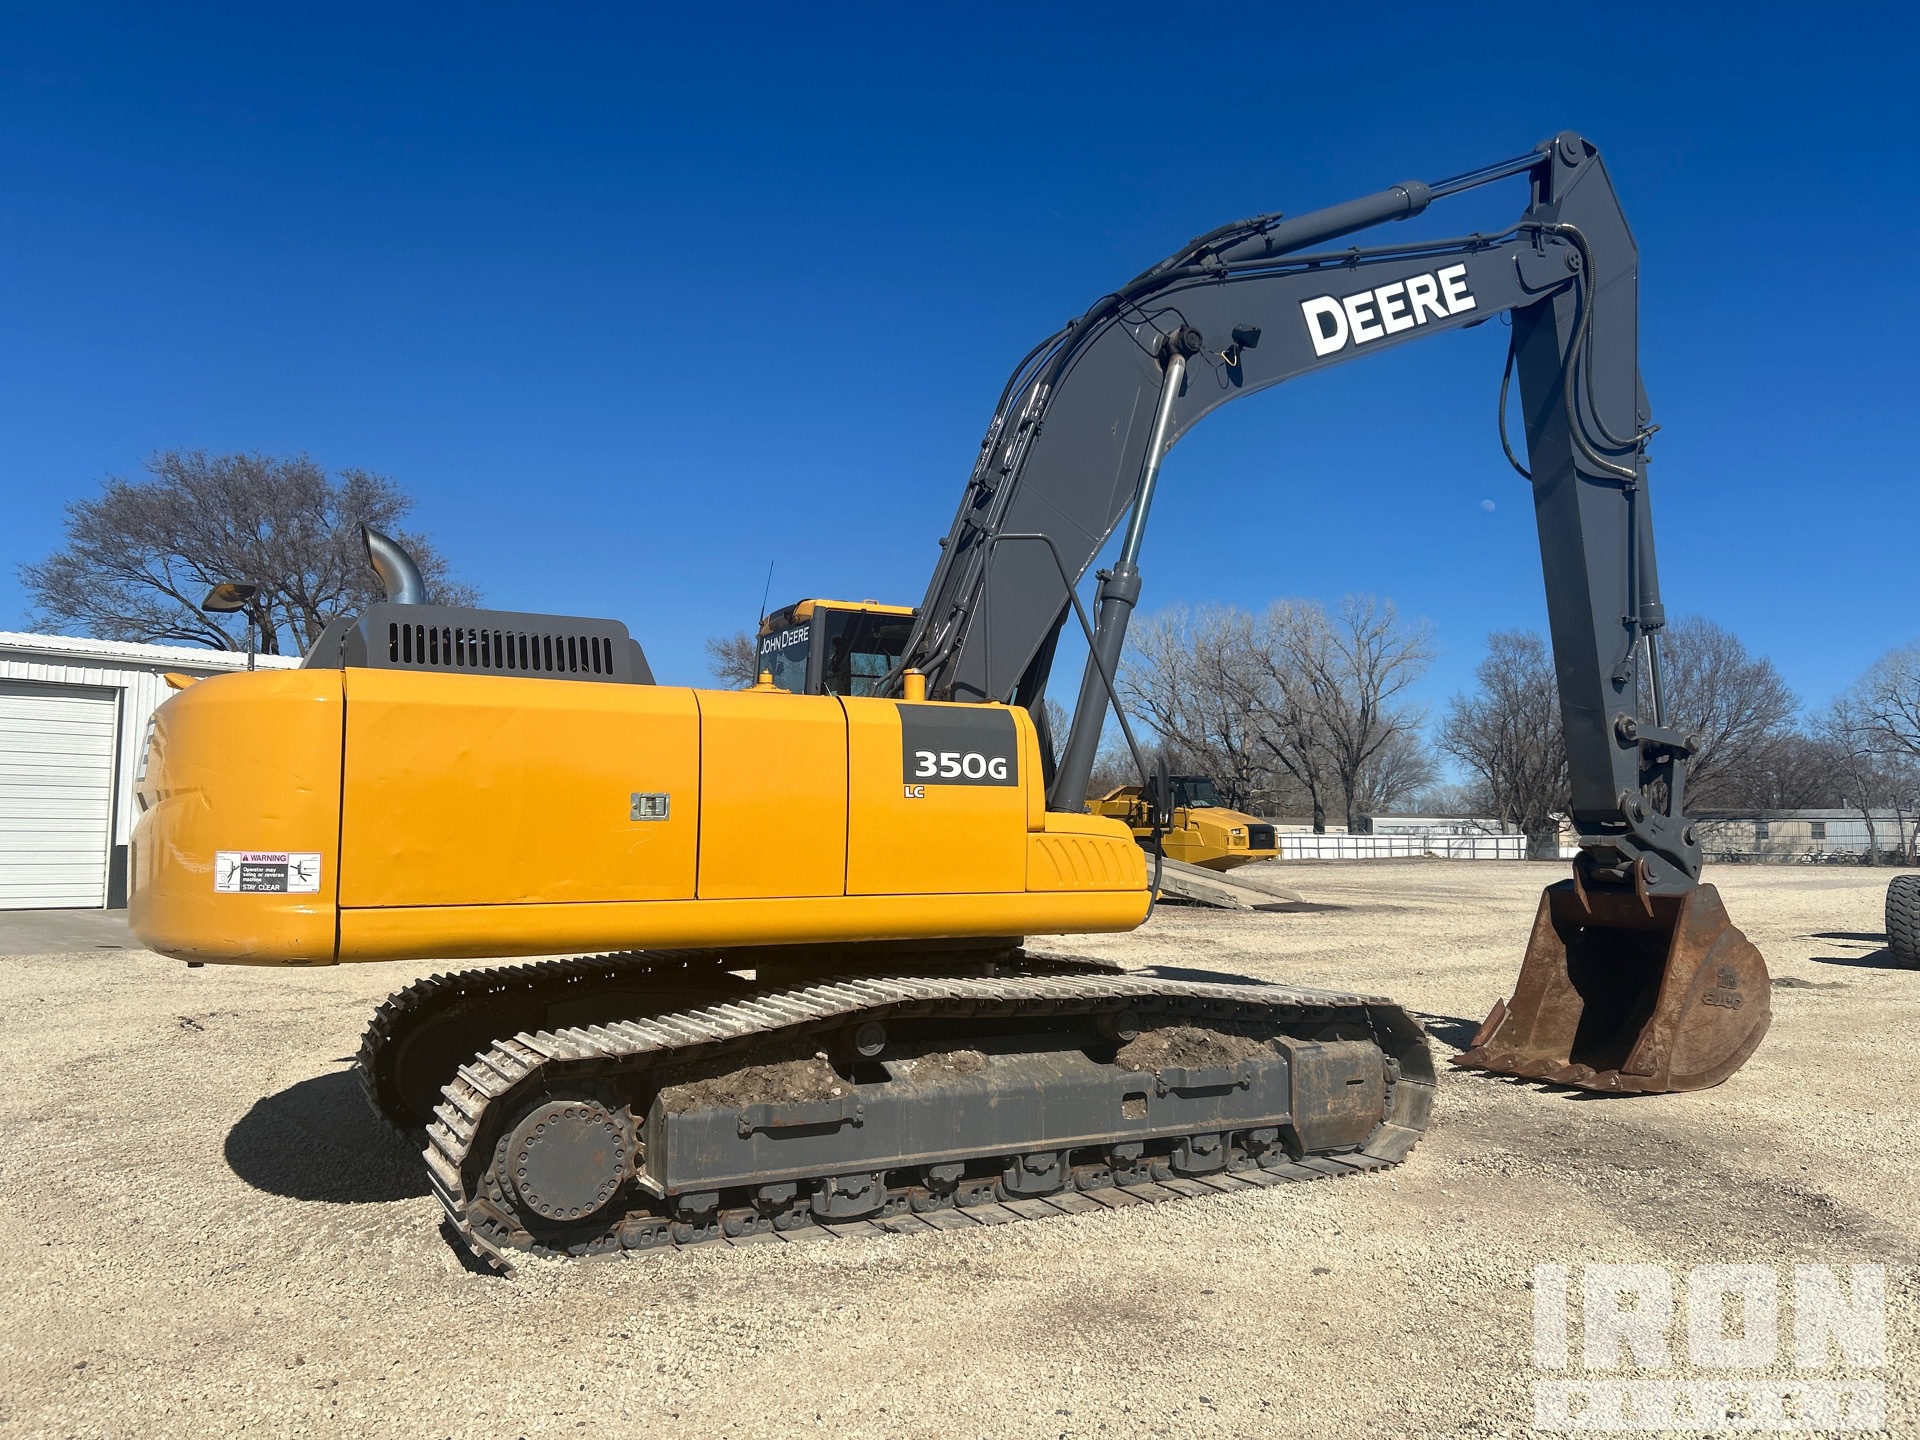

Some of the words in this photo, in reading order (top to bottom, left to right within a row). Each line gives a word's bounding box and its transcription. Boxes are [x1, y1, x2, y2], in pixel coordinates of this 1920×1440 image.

[1301, 263, 1477, 357] DEERE
[760, 634, 782, 655] JOHN
[782, 626, 810, 649] DEERE
[915, 750, 1008, 780] 350G
[904, 786, 924, 798] LC
[250, 854, 287, 862] WARNING
[242, 883, 256, 891] STAY
